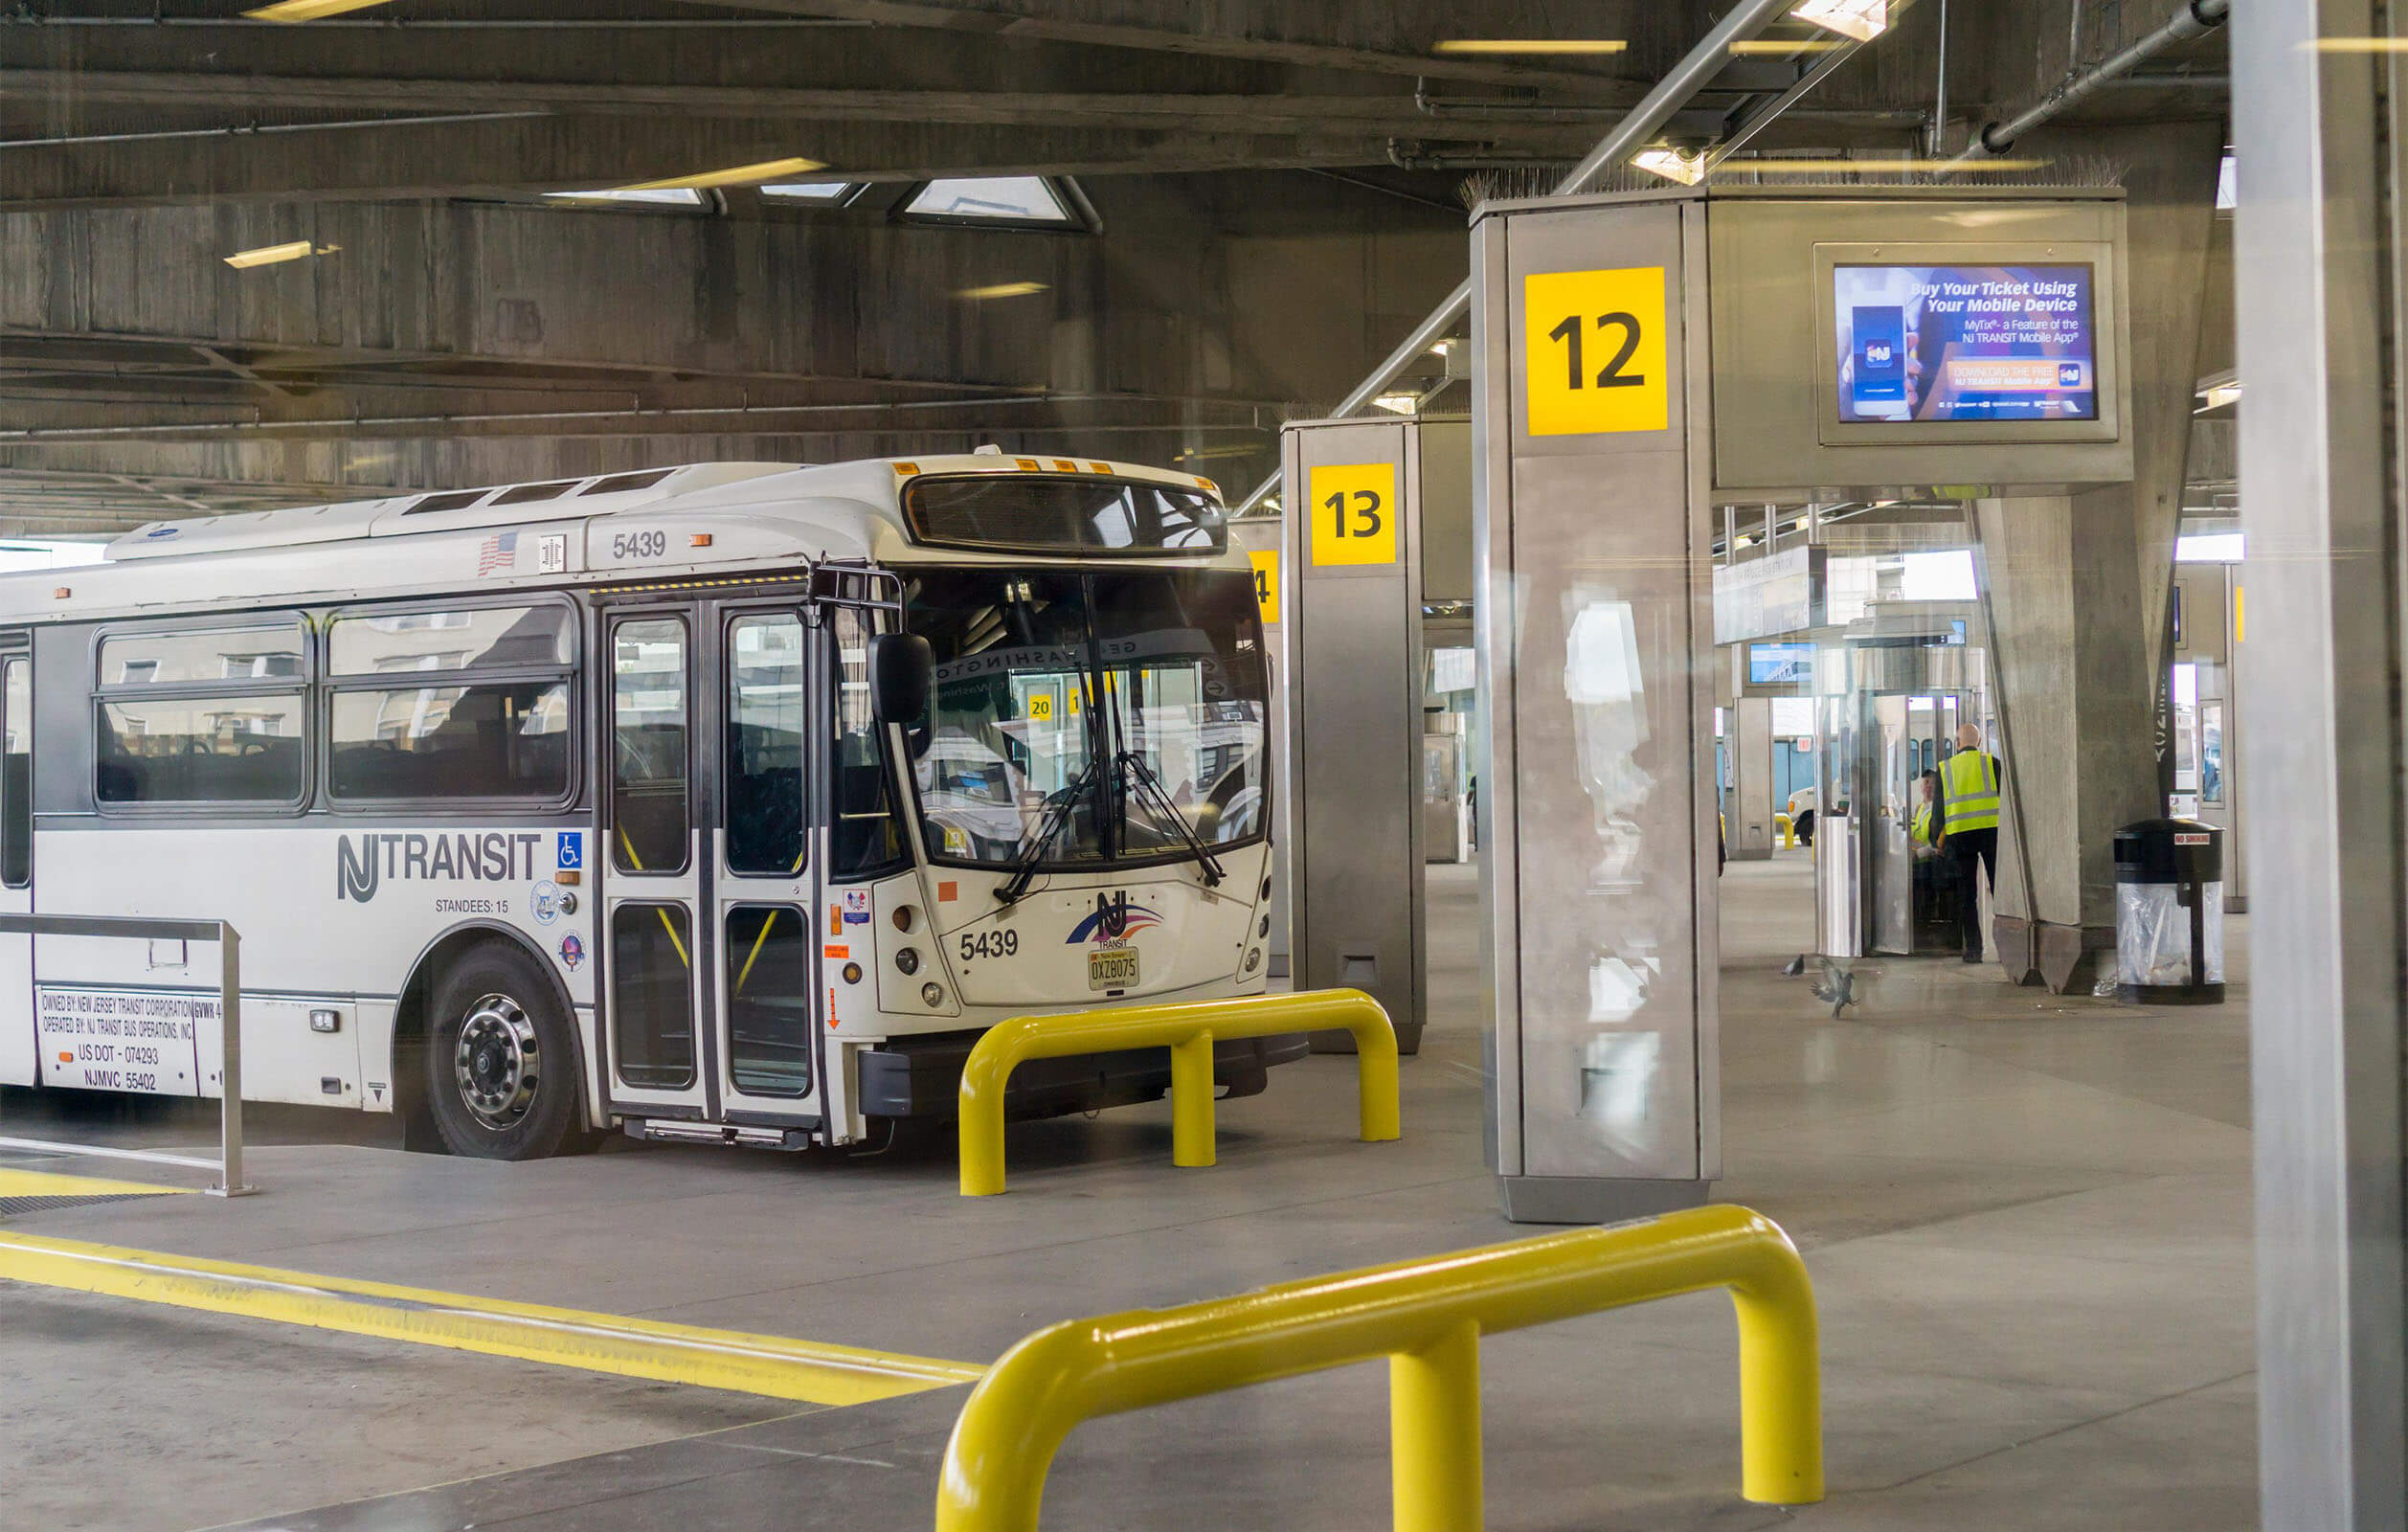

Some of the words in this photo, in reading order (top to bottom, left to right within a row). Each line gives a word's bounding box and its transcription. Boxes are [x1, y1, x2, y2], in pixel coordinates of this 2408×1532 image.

[1910, 282, 1940, 298] Buy
[1943, 282, 1979, 296] Your
[1982, 282, 2030, 296] Ticket
[2033, 282, 2078, 298] Using
[1927, 298, 1964, 312] Your
[1967, 298, 2021, 312] Mobile
[2024, 297, 2078, 312] Device
[2003, 322, 2010, 330] a
[2012, 319, 2048, 330] Feature
[2050, 319, 2060, 329] of
[2062, 319, 2079, 330] the
[1963, 333, 1975, 344] NJ
[1977, 333, 2017, 344] TRANSIT
[2019, 332, 2051, 343] Mobile
[1548, 311, 1646, 391] 12
[1954, 367, 2009, 376] DOWNLOAD
[2012, 367, 2029, 376] THE
[2032, 367, 2055, 376] FREE
[1323, 489, 1382, 539] 13
[613, 530, 665, 559] 5439
[1031, 701, 1049, 715] 20
[436, 899, 494, 913] STANDEES:
[496, 900, 508, 913] 15
[1097, 890, 1127, 937] NJ
[960, 929, 1019, 961] 5439
[1099, 938, 1128, 950] TRANSIT
[42, 995, 65, 1012] OWNED
[66, 995, 78, 1012] BY:
[78, 996, 92, 1013] NEW
[93, 997, 116, 1014] JERSEY
[118, 998, 145, 1016] TRANSIT
[146, 999, 193, 1018] CORPORATION
[194, 1002, 214, 1019] GVWR
[43, 1016, 74, 1033] OPERATED
[76, 1018, 86, 1033] BY:
[87, 1018, 96, 1034] NJ
[97, 1019, 122, 1036] TRANSIT
[124, 1020, 136, 1037] BUS
[139, 1021, 179, 1042] OPERATIONS,
[79, 1044, 93, 1060] US
[95, 1045, 115, 1062] DOT
[124, 1046, 160, 1065] 074293
[84, 1069, 122, 1088] NJMVC
[125, 1071, 157, 1091] 55402
